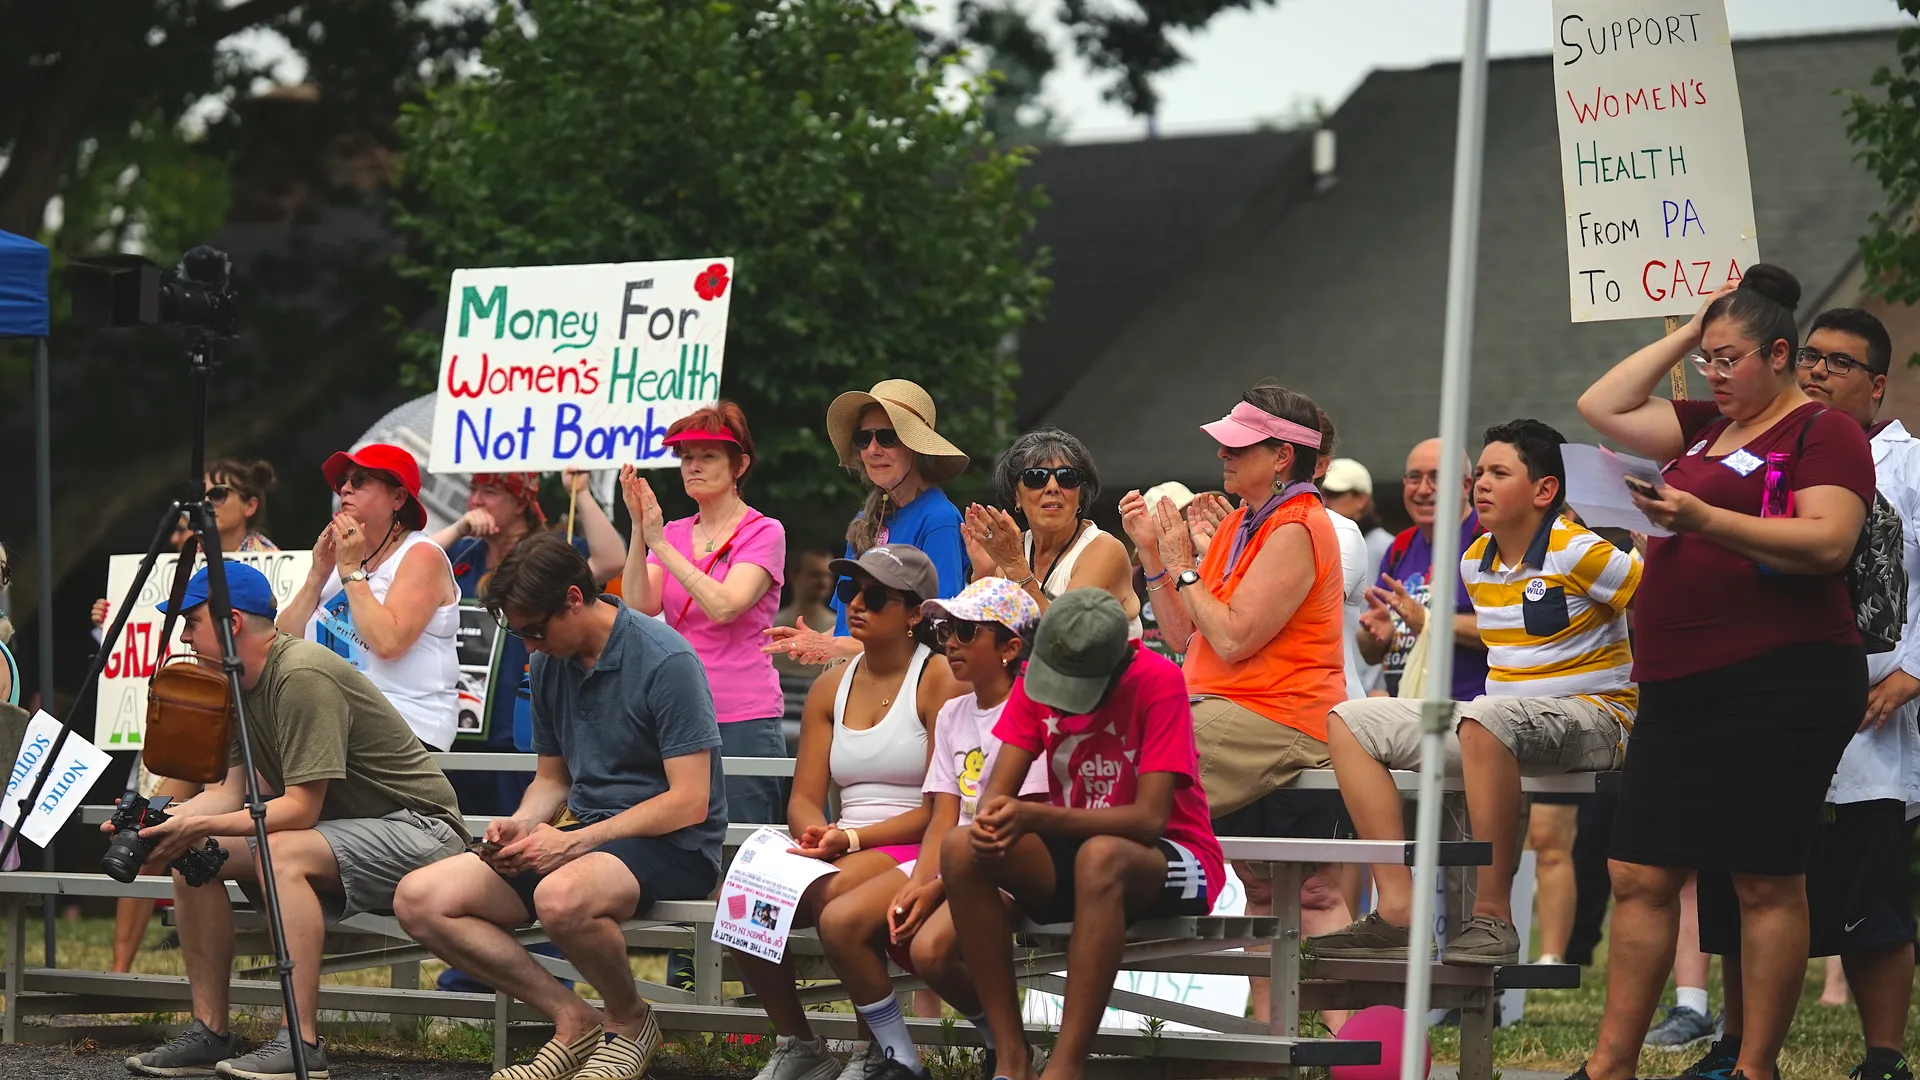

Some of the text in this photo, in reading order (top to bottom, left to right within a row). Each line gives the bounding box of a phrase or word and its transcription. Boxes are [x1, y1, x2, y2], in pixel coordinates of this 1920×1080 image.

[1560, 13, 1700, 65] SUPPORT
[1567, 79, 1707, 124] WOMEN'S
[1576, 141, 1687, 186] HEALTH
[1579, 199, 1705, 248] FROM PA
[1642, 259, 1743, 301] GAZA
[457, 278, 700, 354] Money For
[447, 344, 719, 404] Women's Health
[454, 402, 679, 464] Not Bomb
[1526, 587, 1545, 595] WILD
[39, 759, 89, 815] NOTICE
[720, 920, 738, 932] GAZA
[738, 927, 746, 935] IN
[747, 930, 772, 944] WOMEN
[749, 942, 762, 953] THE
